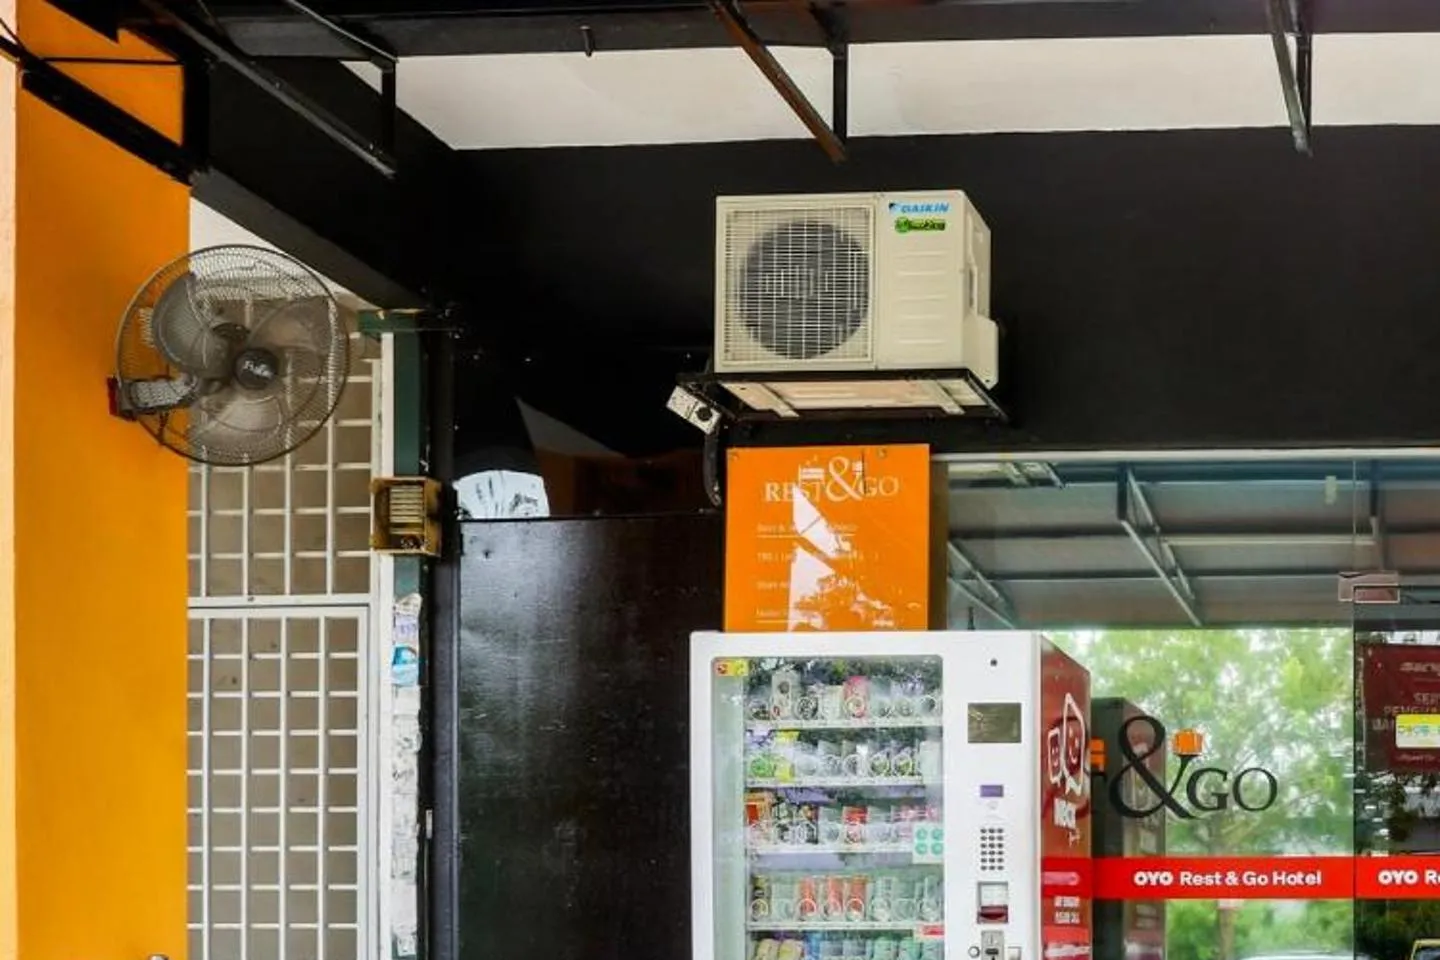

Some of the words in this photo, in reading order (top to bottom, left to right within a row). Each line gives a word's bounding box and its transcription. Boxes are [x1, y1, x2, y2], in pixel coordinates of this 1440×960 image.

[1134, 871, 1174, 886] OYO
[1180, 871, 1222, 886] Rest
[1225, 871, 1239, 886] &
[1242, 871, 1269, 886] Go
[1273, 870, 1322, 886] Hotel
[1378, 869, 1419, 885] OYO
